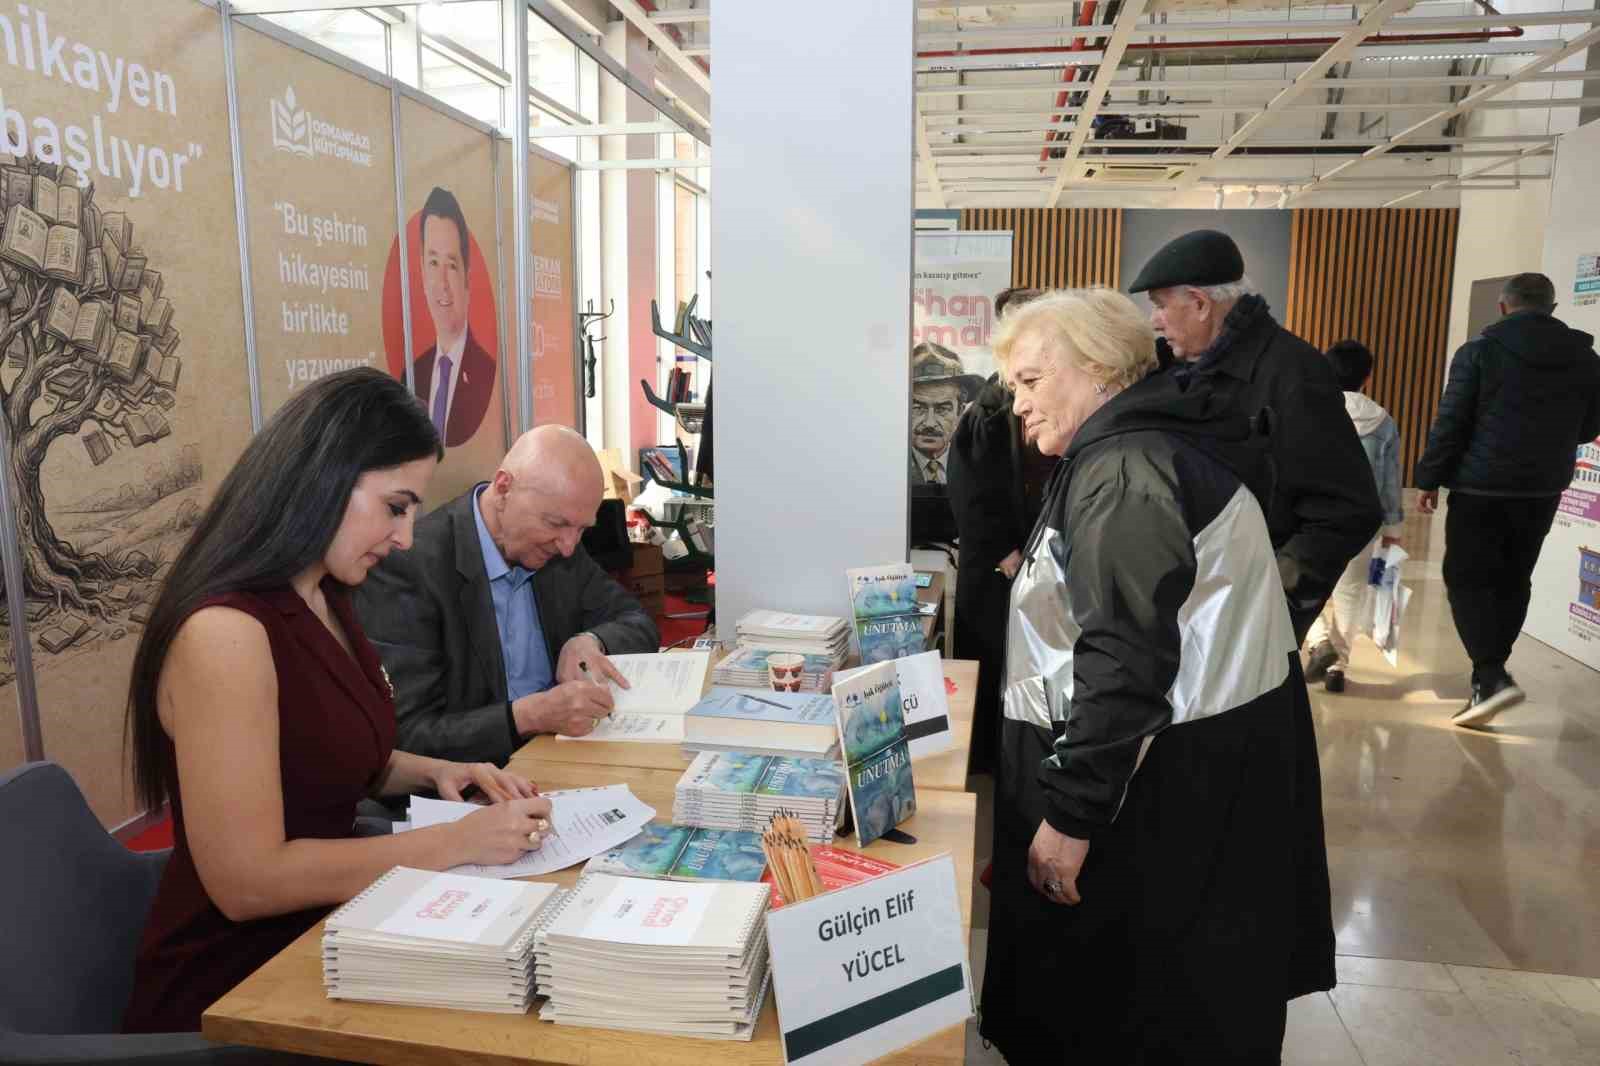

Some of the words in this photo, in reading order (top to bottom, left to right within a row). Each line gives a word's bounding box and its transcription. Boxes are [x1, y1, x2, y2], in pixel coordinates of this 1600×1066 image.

[313, 211, 368, 247] şehrin
[279, 248, 369, 294] hikayesini
[282, 301, 348, 335] birlikte
[857, 751, 905, 788] UNUTMA
[818, 906, 881, 941] Gülçin
[886, 889, 915, 919] Elif
[841, 944, 905, 983] YÜCEL
